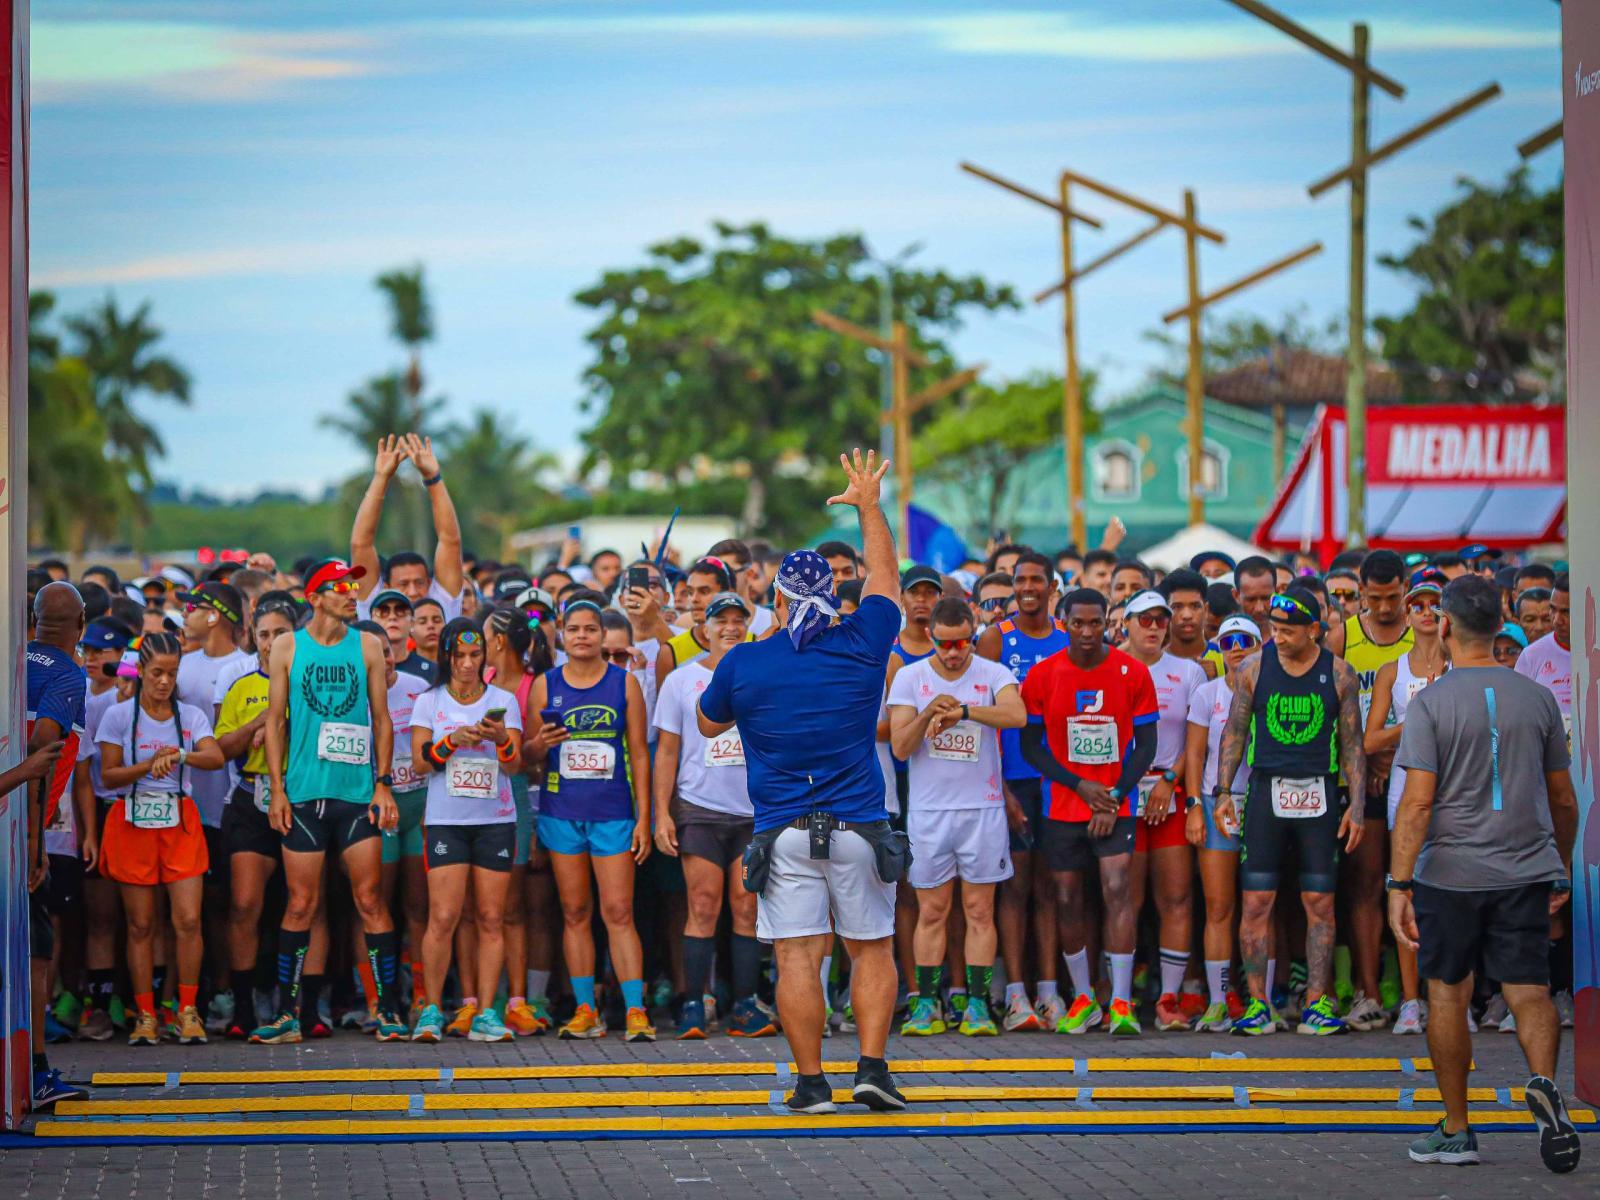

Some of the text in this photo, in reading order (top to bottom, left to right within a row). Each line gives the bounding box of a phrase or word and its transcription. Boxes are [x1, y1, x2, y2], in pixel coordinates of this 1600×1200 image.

[1388, 424, 1550, 478] MEDALHA
[27, 651, 55, 667] AGEM
[316, 665, 346, 684] CLUB
[1279, 696, 1311, 714] CLUB
[326, 736, 366, 754] 2515
[711, 740, 742, 755] 424
[1074, 738, 1113, 754] 2854
[567, 754, 609, 769] 5351
[453, 771, 493, 787] 5203
[1279, 792, 1321, 807] 5025
[134, 803, 172, 819] 2757
